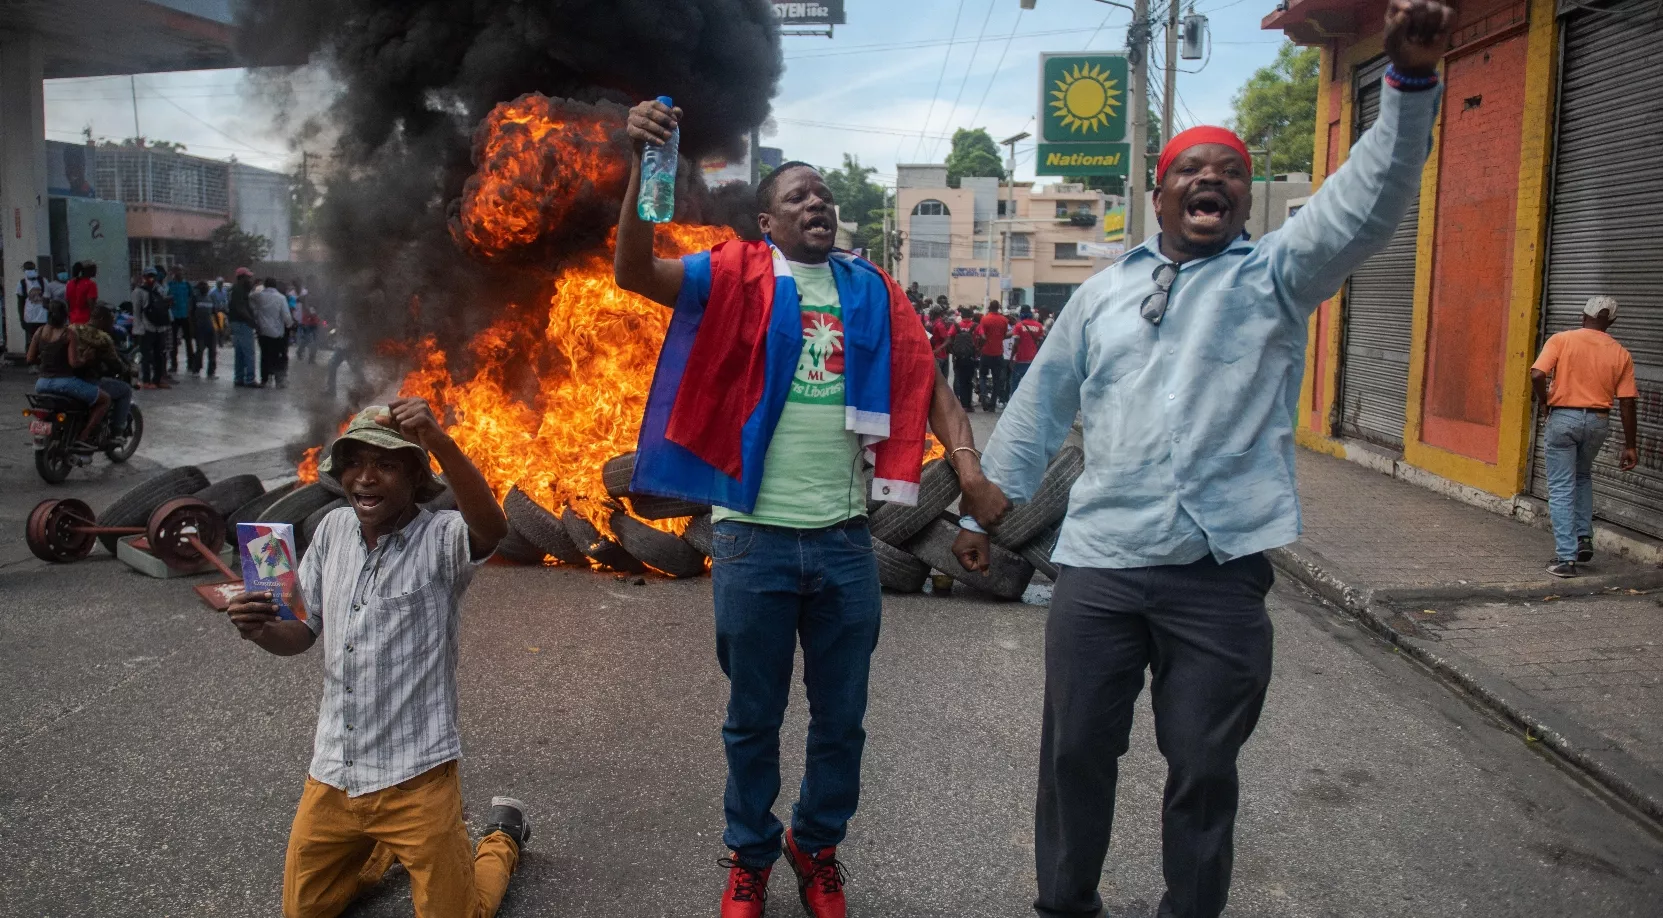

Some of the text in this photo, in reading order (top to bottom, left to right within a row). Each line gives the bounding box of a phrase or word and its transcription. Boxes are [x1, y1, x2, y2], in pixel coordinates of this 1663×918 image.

[1046, 152, 1121, 166] National
[88, 218, 104, 240] 2
[808, 370, 825, 381] ML
